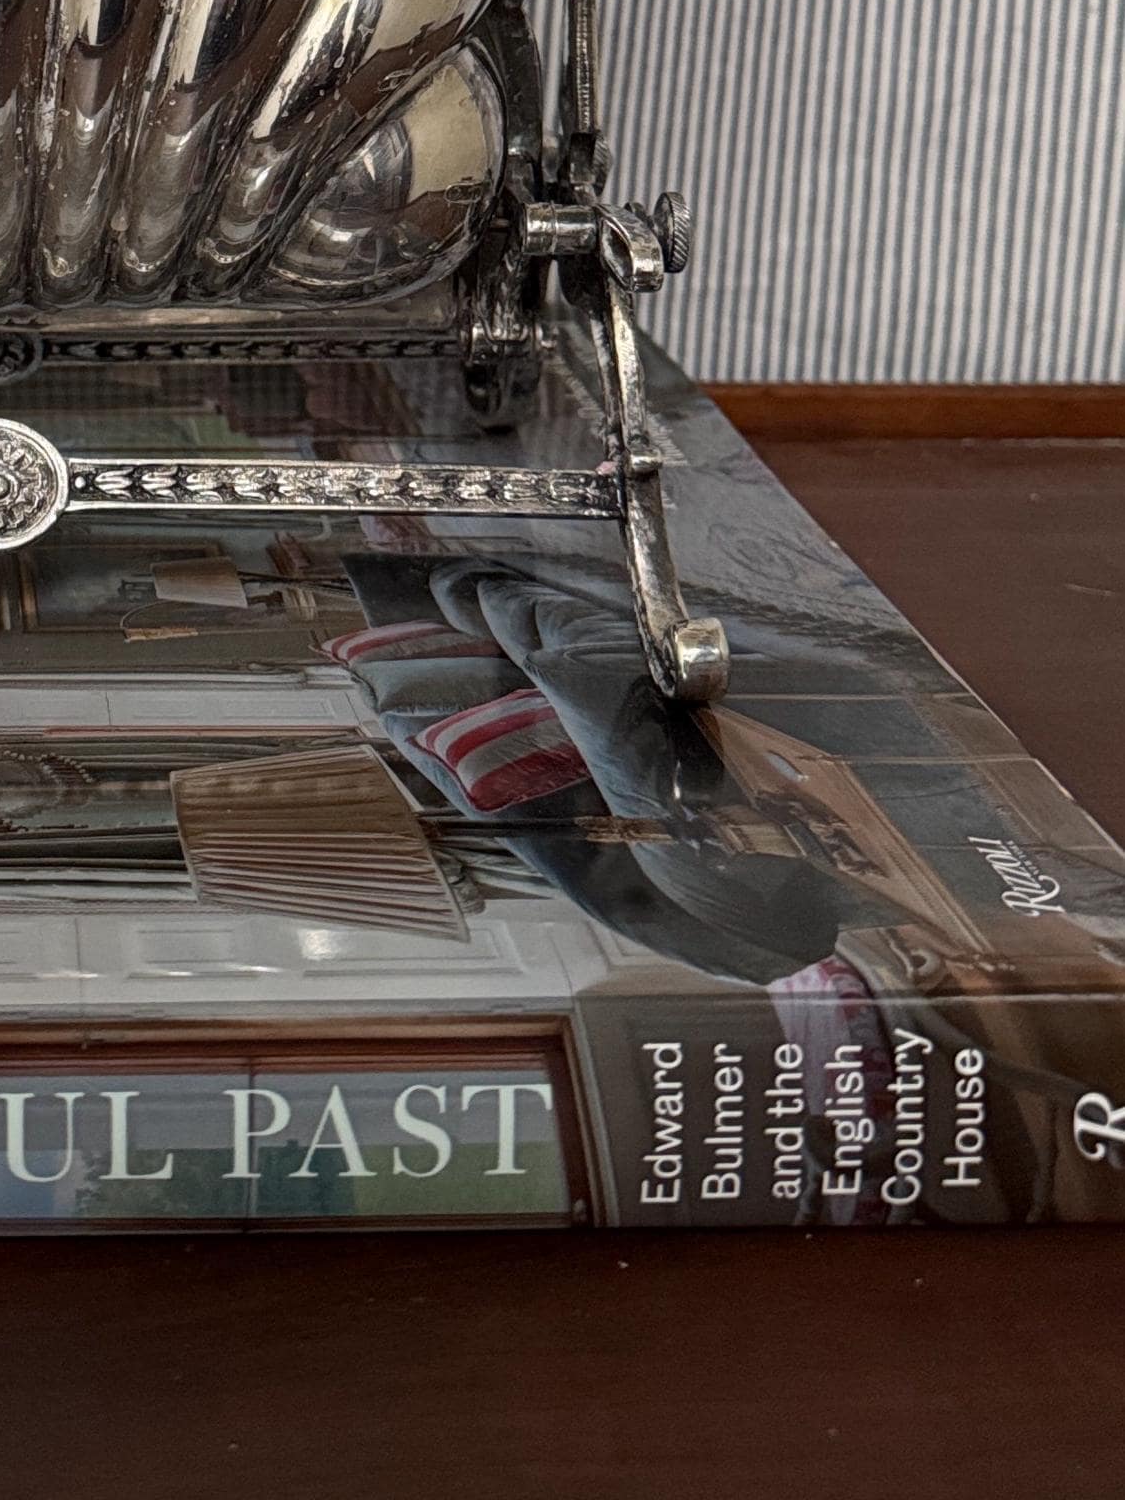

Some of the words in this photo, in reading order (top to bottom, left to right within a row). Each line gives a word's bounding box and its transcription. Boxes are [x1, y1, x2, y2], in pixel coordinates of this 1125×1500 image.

[222, 1082, 554, 1180] PAST
[641, 1041, 682, 1204] Edward
[701, 1043, 744, 1200] Bulmer
[765, 1042, 804, 1118] the
[822, 1044, 874, 1197] English
[881, 1027, 933, 1206] Country
[942, 1047, 985, 1187] House
[765, 1127, 804, 1199] and
